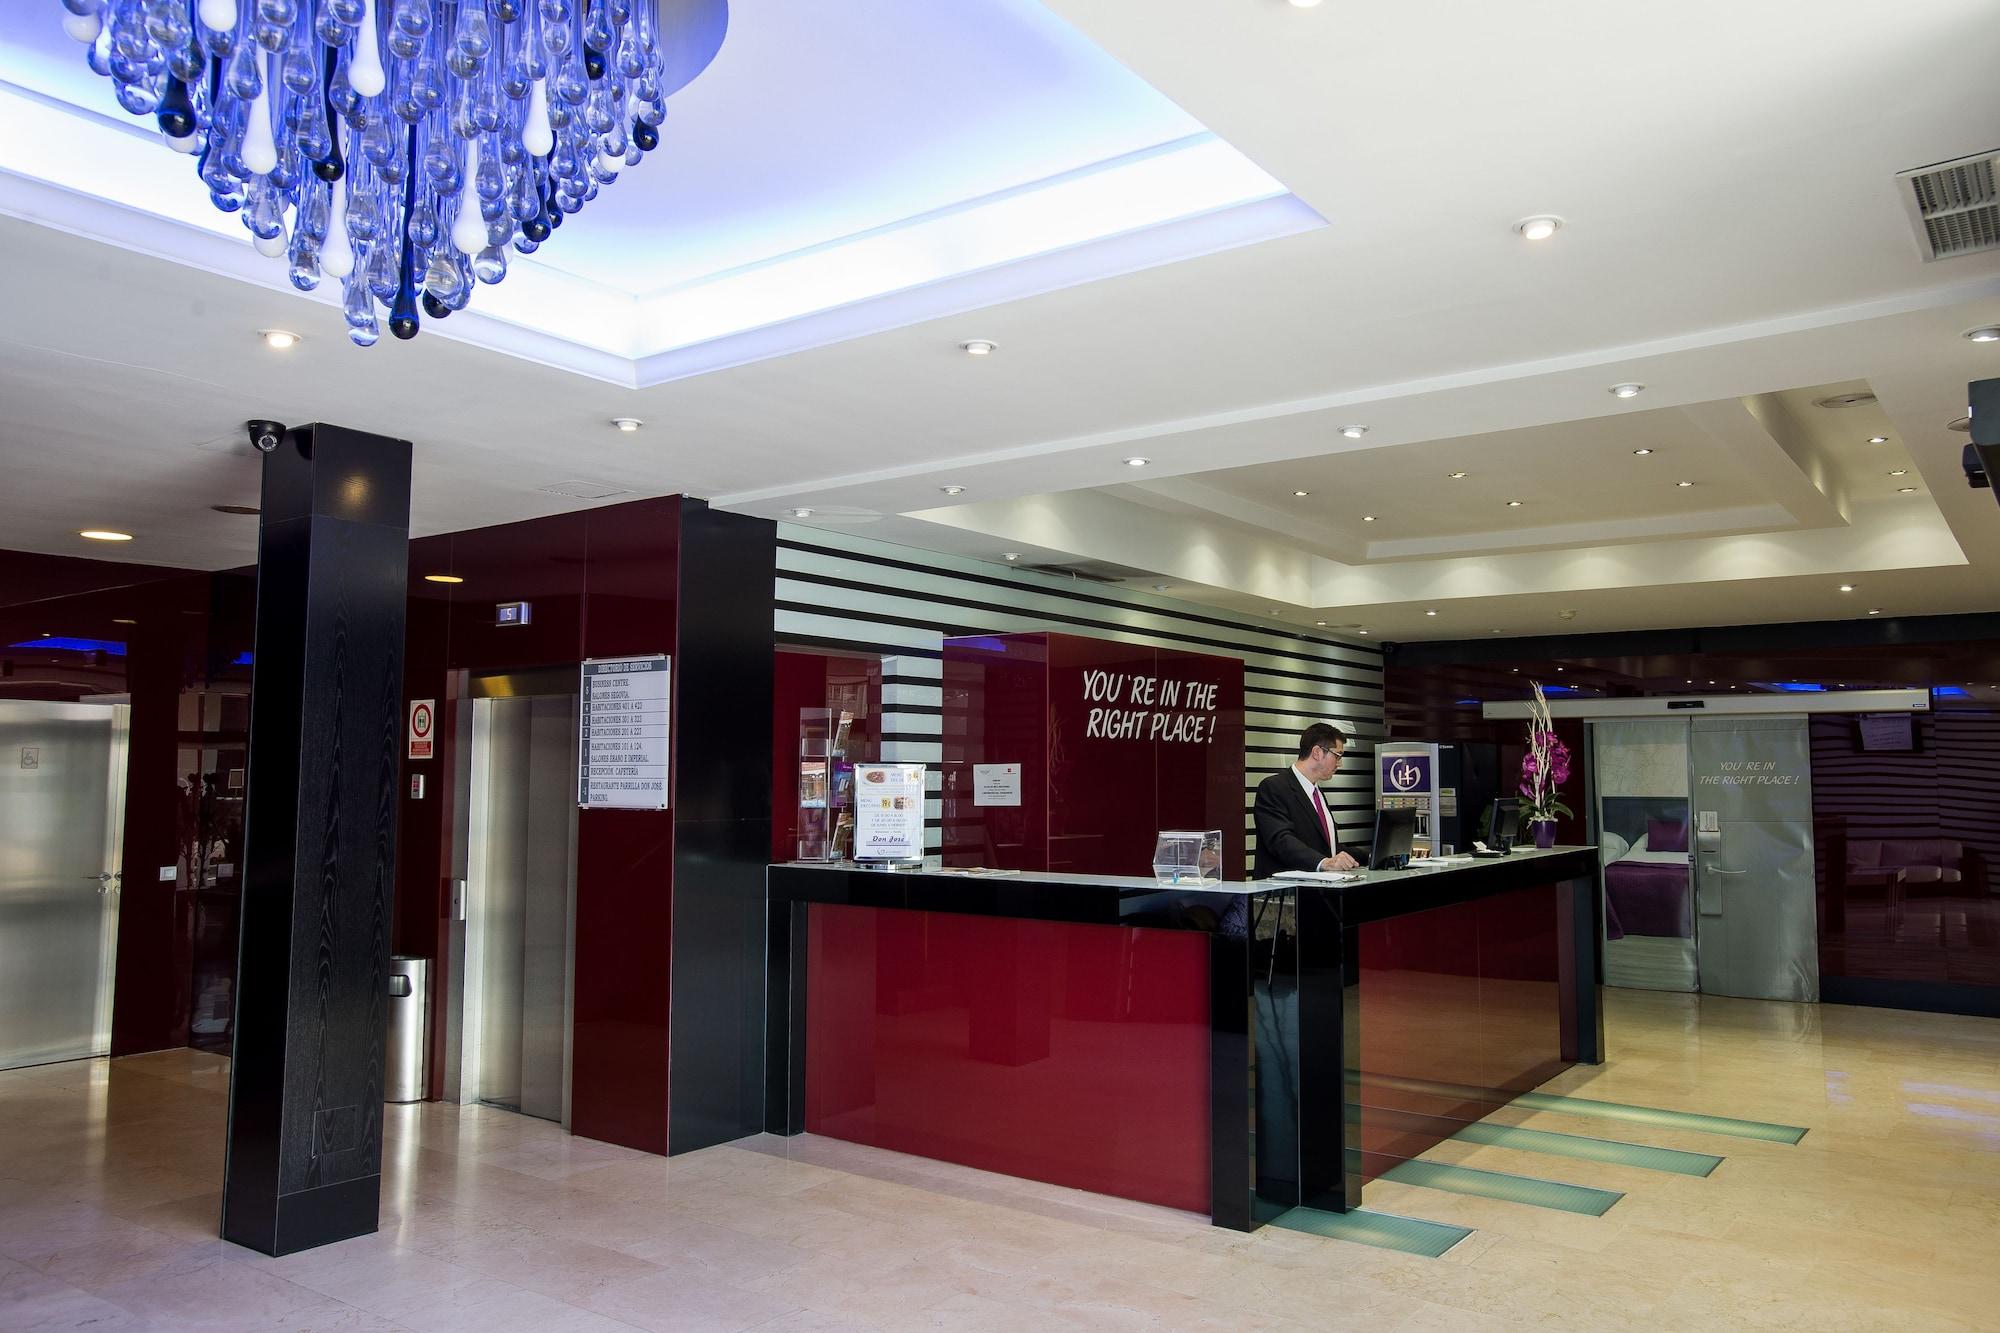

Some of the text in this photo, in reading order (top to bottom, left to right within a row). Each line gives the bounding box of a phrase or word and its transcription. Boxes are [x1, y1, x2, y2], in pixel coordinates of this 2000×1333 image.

[506, 607, 512, 620] 5
[1083, 669, 1123, 702] YOU
[1160, 680, 1181, 707] IN
[1186, 682, 1218, 711] THE
[1086, 708, 1149, 739] RIGHT
[1720, 762, 1742, 770] YOU
[1763, 762, 1776, 770] IN
[1700, 776, 1719, 784] THE
[1722, 776, 1756, 784] RIGHT
